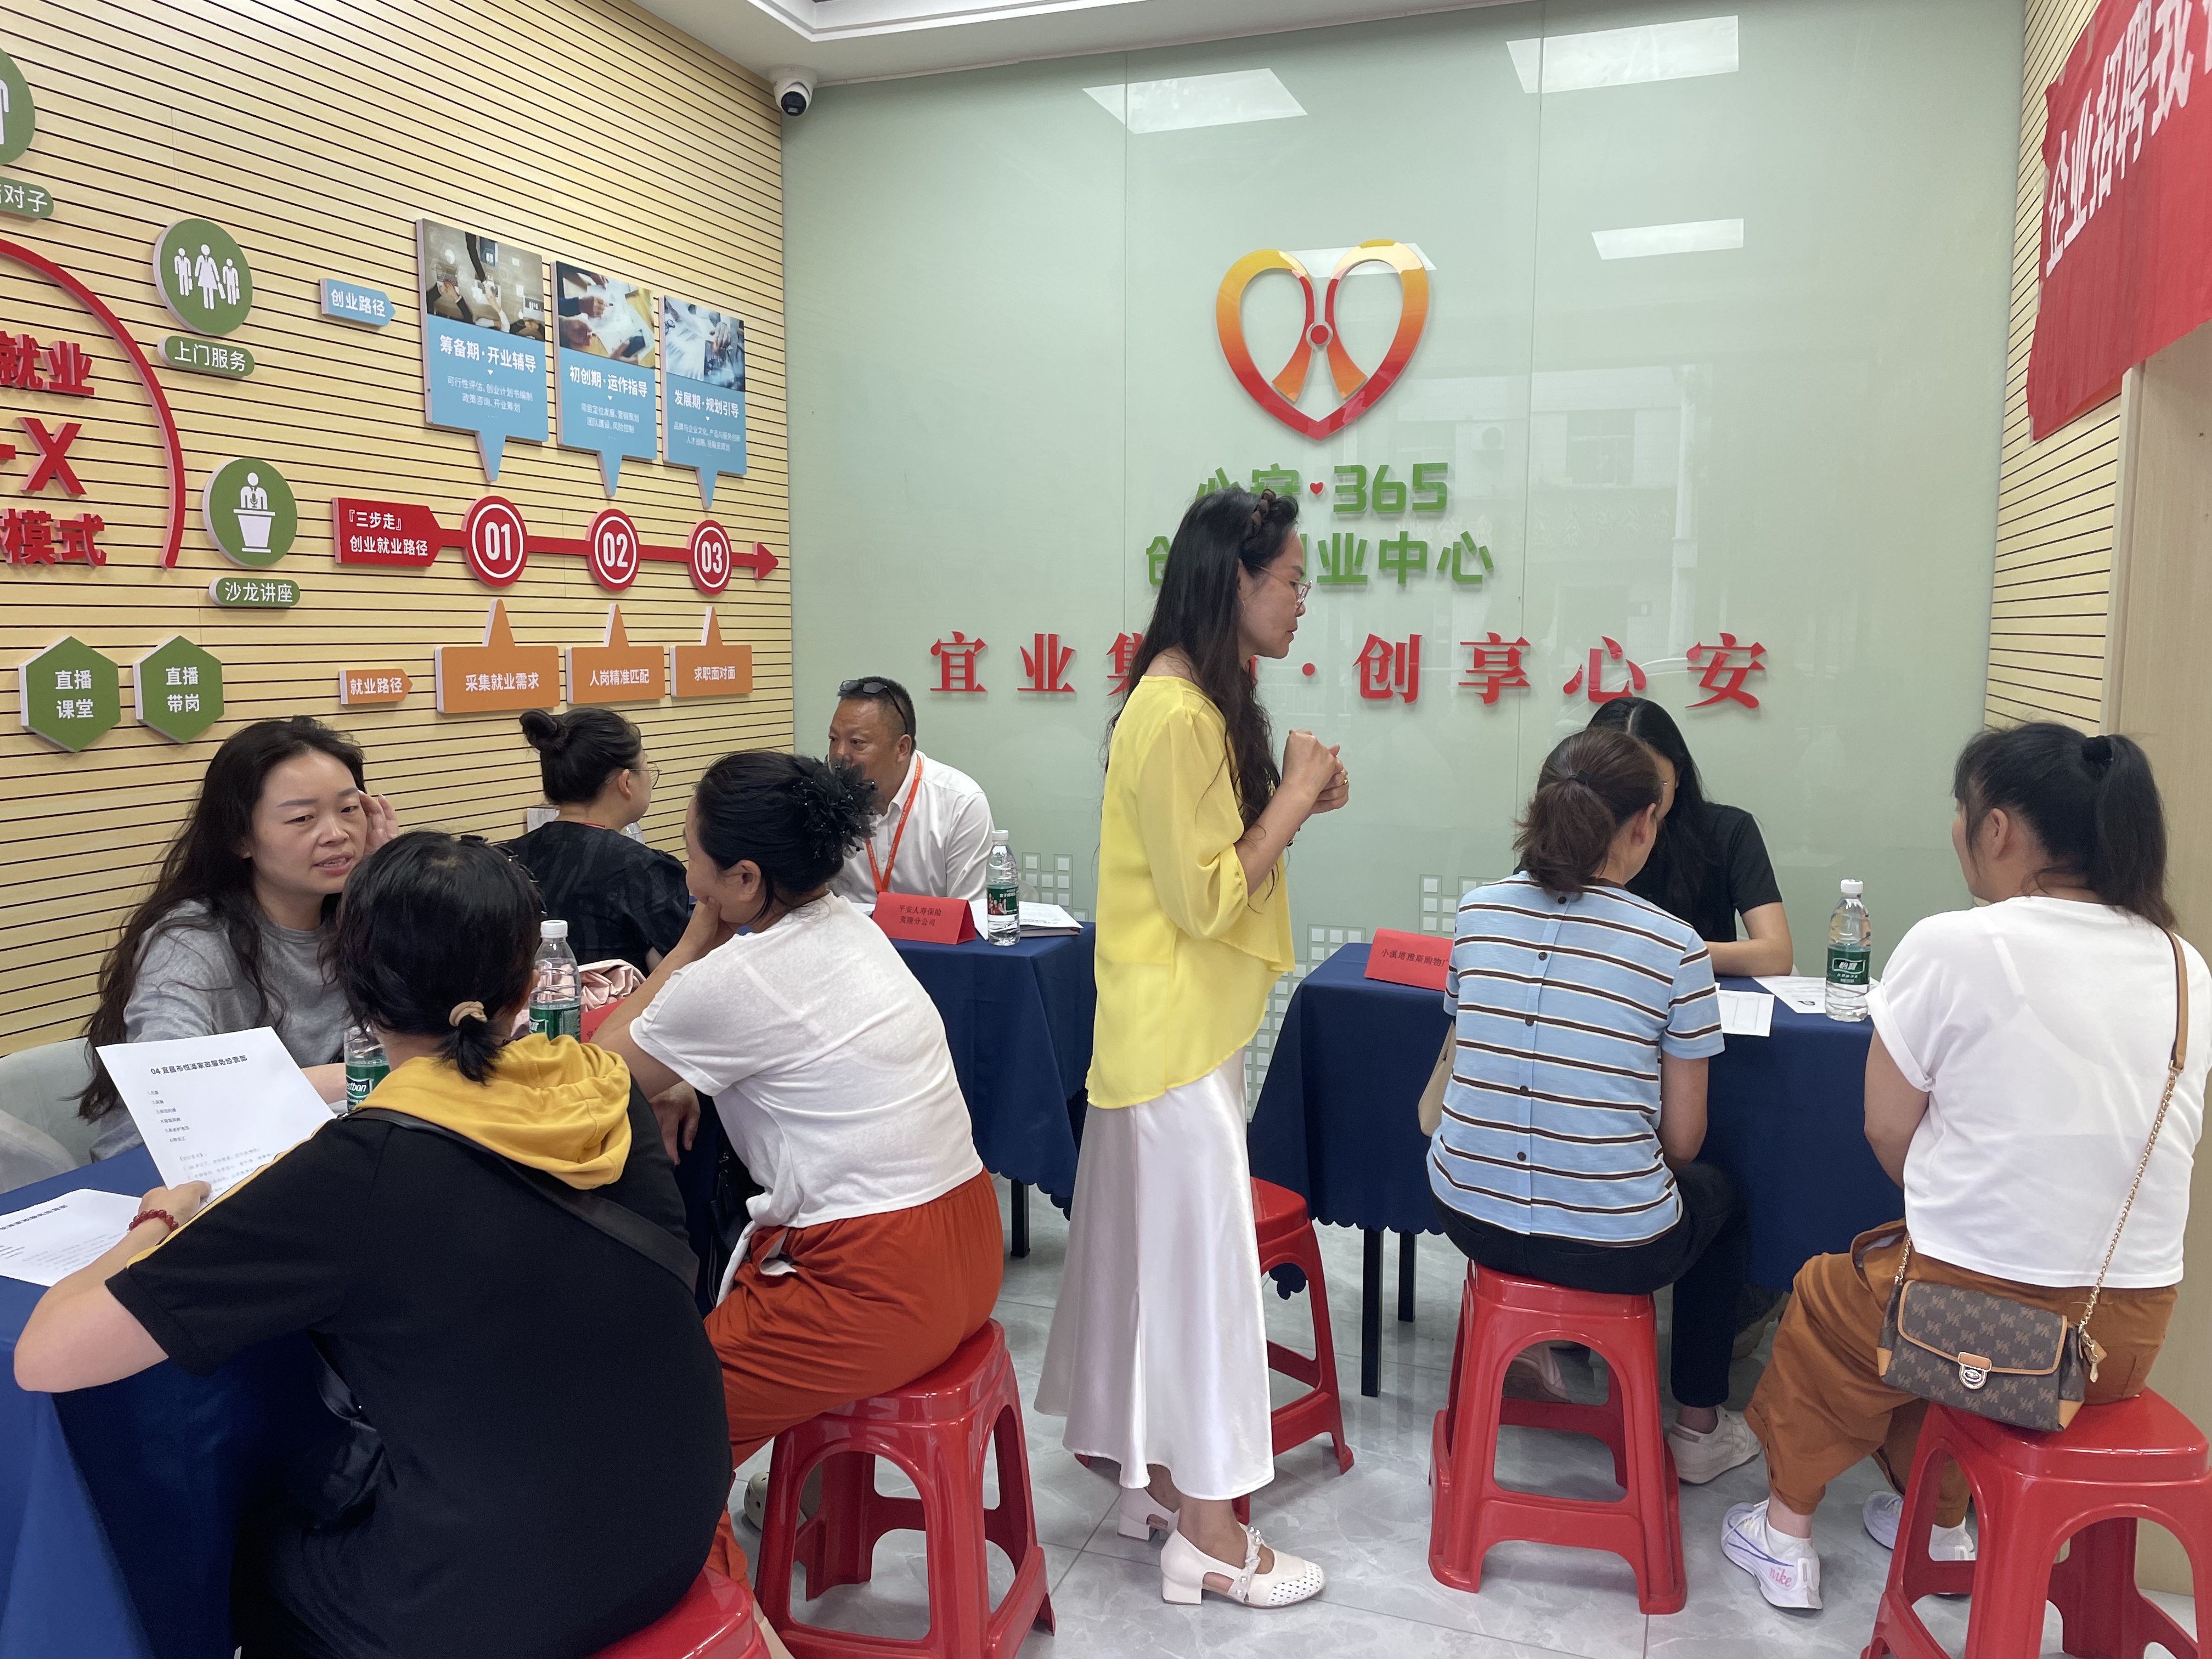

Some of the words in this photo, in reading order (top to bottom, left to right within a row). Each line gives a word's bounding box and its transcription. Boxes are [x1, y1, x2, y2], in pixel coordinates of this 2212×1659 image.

[0, 183, 48, 212] 对子
[331, 289, 386, 318] 创业路径
[174, 341, 245, 372] 上门服务
[440, 334, 537, 373] 筹备期·开业辅导
[569, 364, 648, 398] 初创期·运作指导
[674, 389, 739, 418] 发展期·规划引导
[349, 509, 402, 531] 『三步走』
[349, 535, 428, 556] 创业就业路径
[485, 522, 511, 561] 01
[603, 532, 628, 568] 02
[702, 541, 723, 574] 03
[225, 582, 293, 603] 沙龙讲座
[55, 669, 92, 690] 直播
[166, 667, 199, 686] 直播
[465, 672, 539, 693] 采集就业需求
[589, 668, 650, 686] 人岗精准匹配
[694, 665, 736, 681] 求职面对面
[350, 678, 403, 696] 就业路径
[57, 698, 94, 719] 课堂
[167, 693, 200, 713] 带岗
[899, 905, 942, 917] 平安人寿保险
[899, 916, 936, 927] 夷陵分公司
[1769, 1567, 1792, 1587] nike
